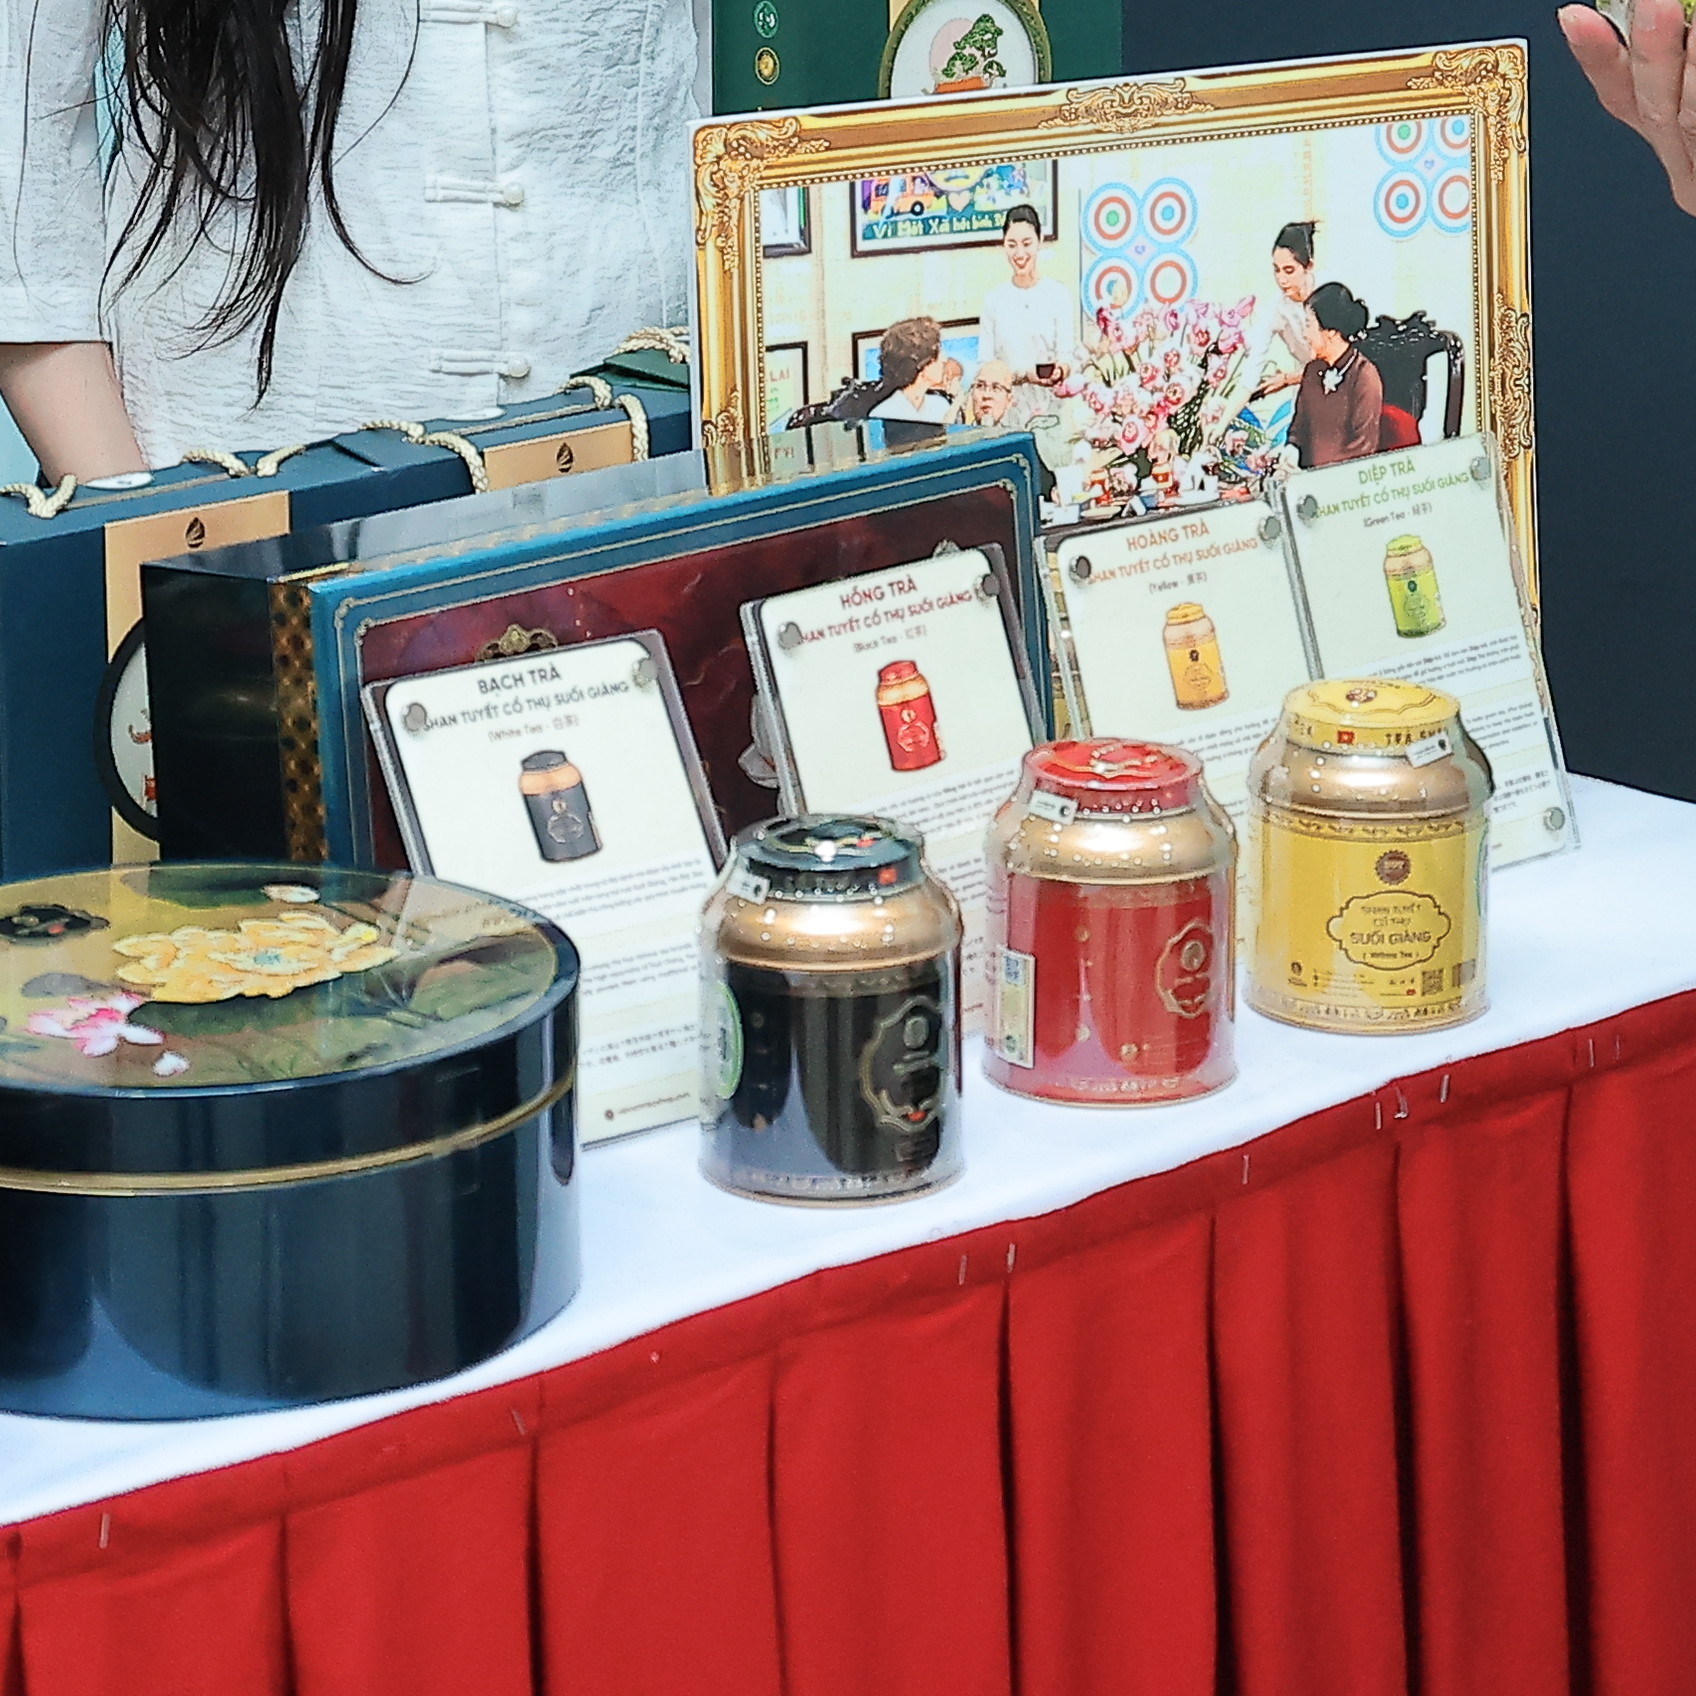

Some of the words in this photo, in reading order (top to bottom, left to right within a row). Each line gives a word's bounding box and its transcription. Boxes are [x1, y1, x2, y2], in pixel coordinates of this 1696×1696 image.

[1358, 463, 1387, 485] DIỆP
[1389, 456, 1416, 477] TRÀ
[1341, 492, 1371, 512] TUYẾT
[1412, 477, 1436, 495] SUỐI
[1126, 527, 1180, 552] HOÀNG
[1184, 517, 1211, 540] TRÀ
[1119, 559, 1151, 578] TUYẾT
[1196, 542, 1222, 561] SUỐI
[840, 585, 886, 610] HỒNG
[889, 574, 918, 597] TRÀ
[801, 627, 825, 645] HAN
[827, 617, 861, 637] TUYẾT
[477, 672, 524, 697] BẠCH
[529, 662, 562, 686] TRÀ
[460, 702, 499, 723] TUYẾT
[554, 685, 585, 707] SUỐI
[587, 681, 630, 700] GIÀNG
